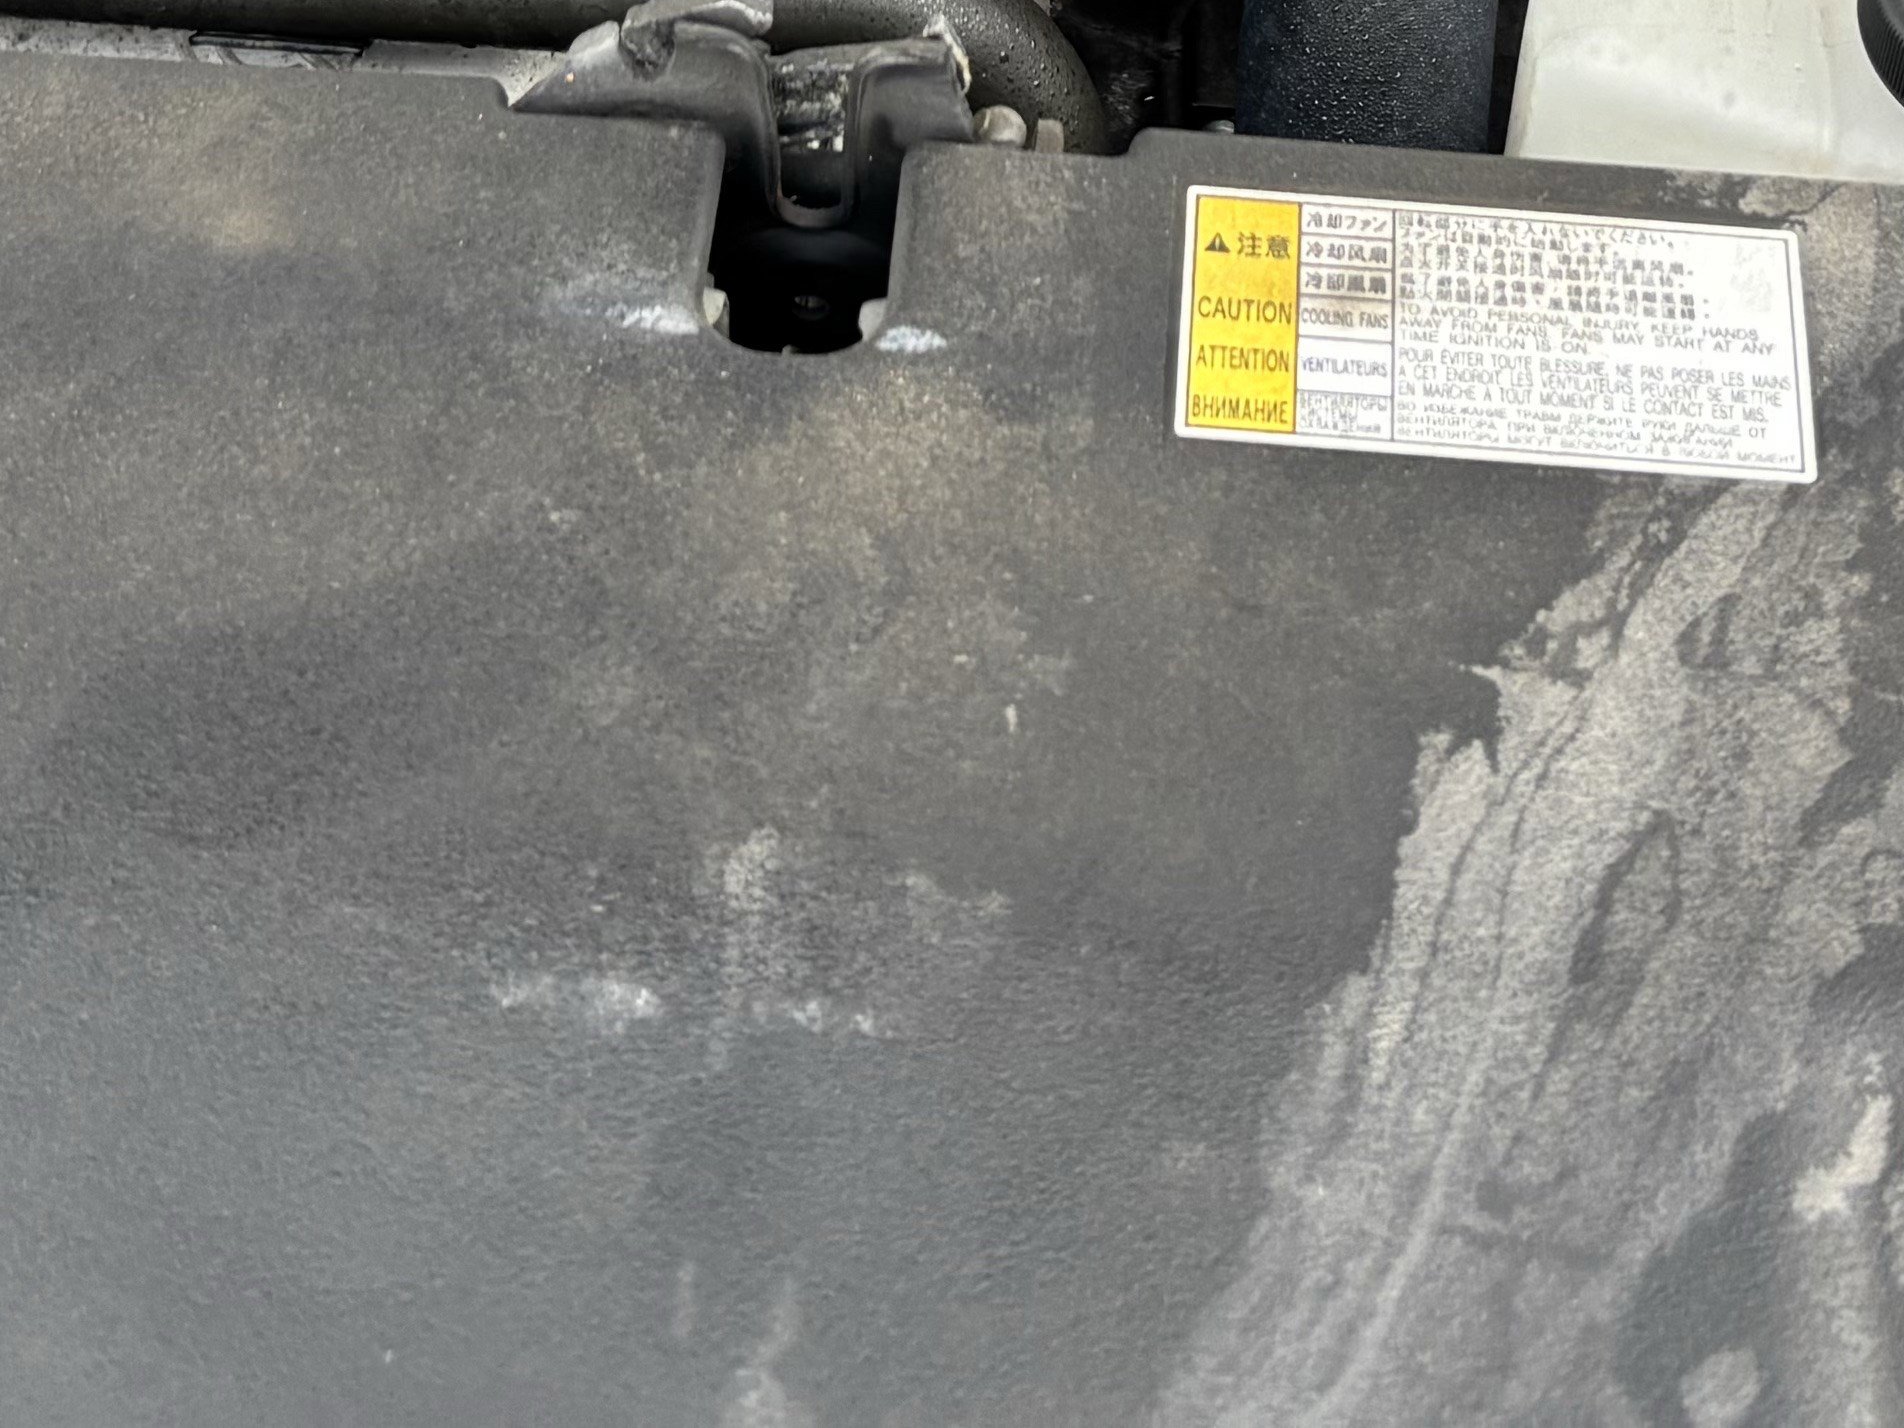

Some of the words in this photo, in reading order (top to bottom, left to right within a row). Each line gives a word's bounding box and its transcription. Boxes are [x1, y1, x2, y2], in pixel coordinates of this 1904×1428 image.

[1237, 231, 1291, 260] 注意
[1197, 294, 1291, 326] CAUTION
[1300, 307, 1354, 327] COOLING
[1358, 311, 1389, 329] FANS
[1429, 303, 1477, 320] AVOID
[1650, 319, 1692, 335] KEEP
[1702, 324, 1758, 341] HANDS
[1399, 315, 1441, 330] AWAY
[1451, 319, 1497, 334] FROM
[1561, 327, 1602, 343] FANS
[1612, 332, 1644, 346] MAY
[1654, 335, 1701, 350] START
[1712, 339, 1732, 352] AT
[1741, 341, 1774, 355] ANY
[1400, 328, 1439, 344] TIME
[1449, 332, 1525, 350] IGNITION
[1195, 342, 1289, 374] ATTENTION
[1301, 356, 1388, 378] VENTILATEURS
[1399, 346, 1433, 363] POUR
[1491, 352, 1532, 370] TOUTE
[1615, 362, 1633, 378] NE
[1640, 364, 1664, 381] PAS
[1671, 366, 1714, 385] POSER
[1721, 370, 1744, 387] LES
[1752, 373, 1791, 391] MAINS
[1398, 380, 1415, 396] EN
[1422, 382, 1475, 400] MARCHE
[1499, 387, 1533, 405] TOUT
[1539, 390, 1595, 409] MOMENT
[1603, 395, 1613, 411] SI
[1621, 397, 1636, 412] LE
[1643, 398, 1703, 417] CONTACT
[1711, 403, 1735, 420] EST
[1413, 363, 1437, 380] CET
[1510, 371, 1533, 387] LES
[1541, 373, 1633, 395] VENTILATEURS
[1640, 381, 1698, 400] PEUVENT
[1706, 386, 1722, 402] SE
[1730, 388, 1782, 407] METTRE
[1191, 394, 1287, 423] ВНИМАНИЕ
